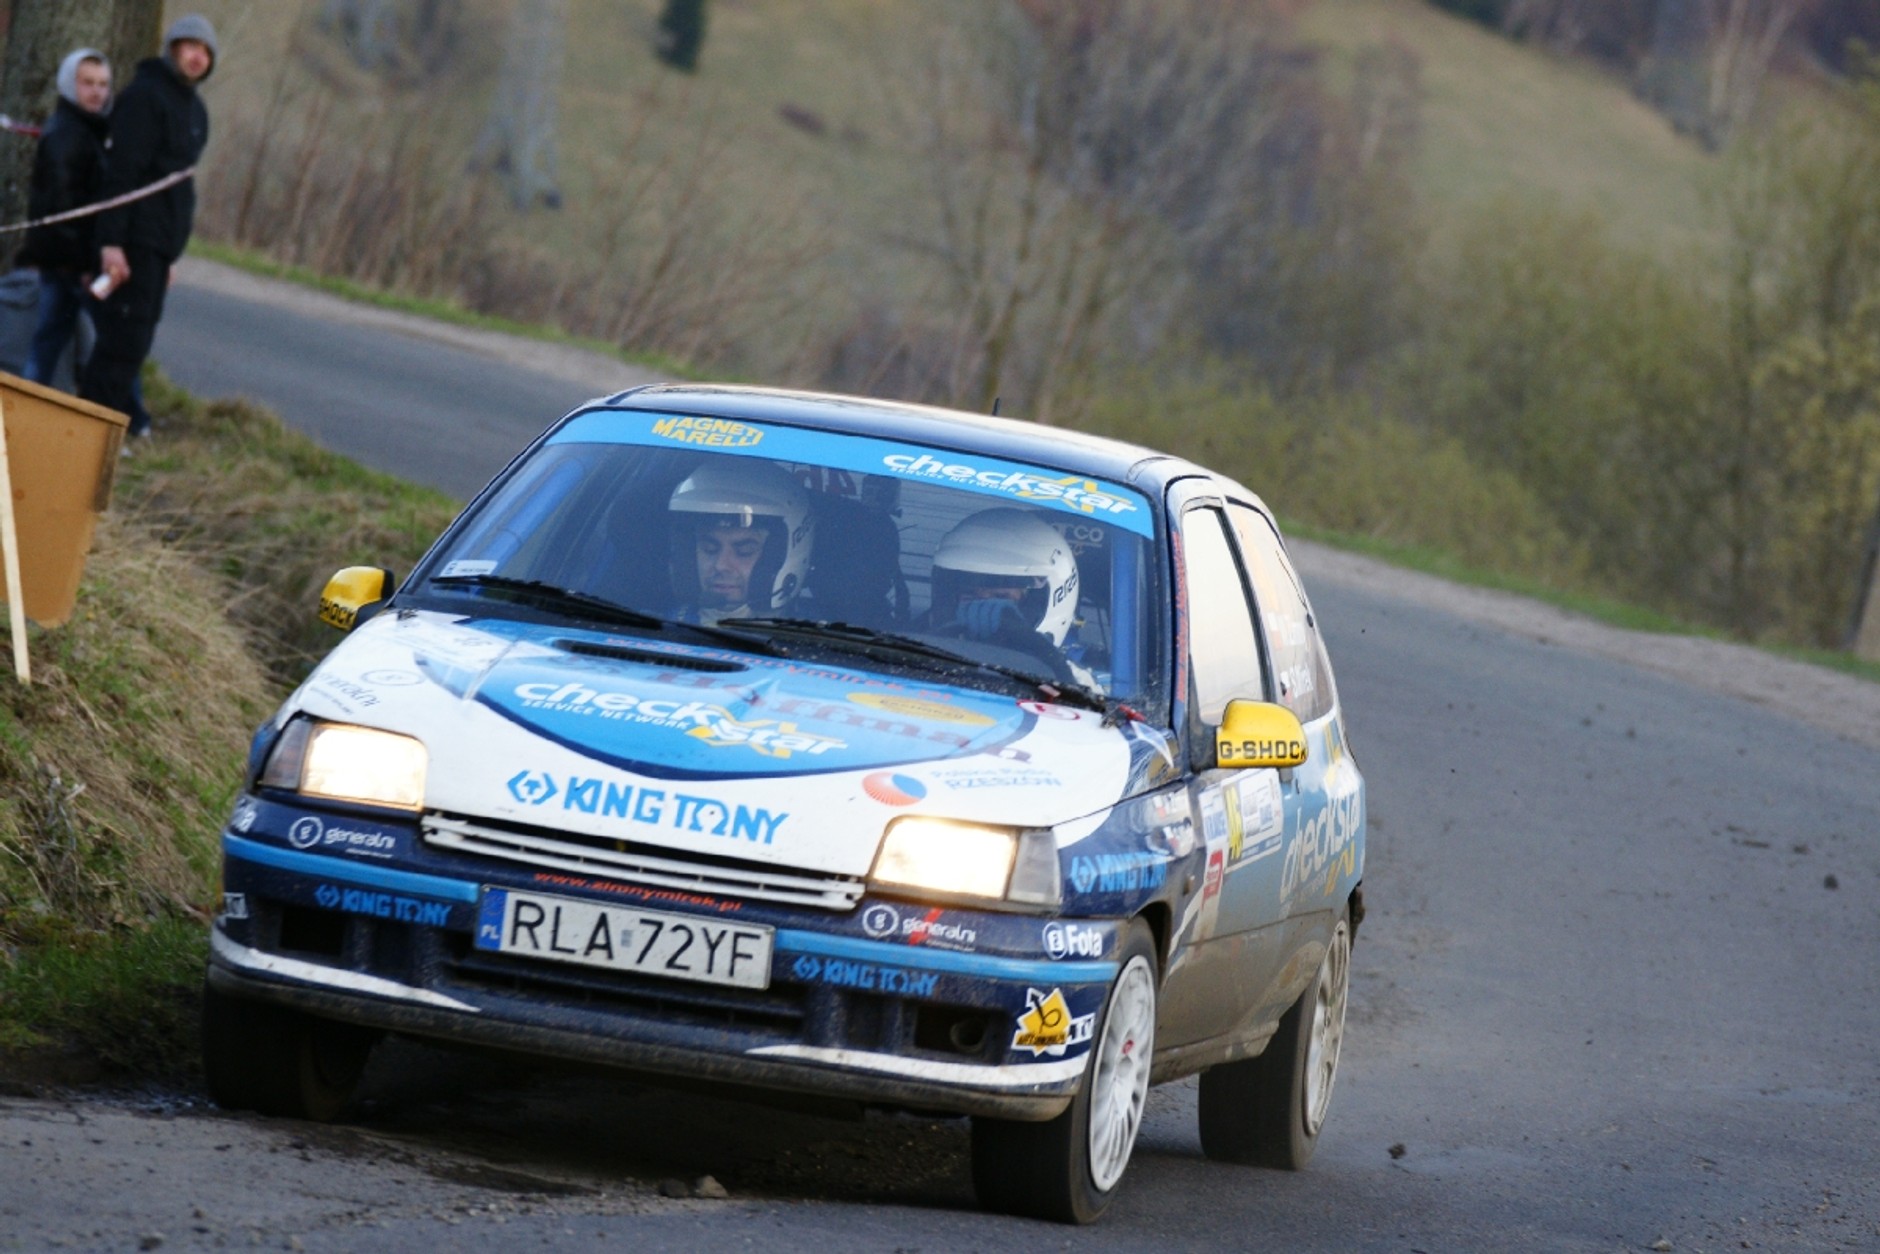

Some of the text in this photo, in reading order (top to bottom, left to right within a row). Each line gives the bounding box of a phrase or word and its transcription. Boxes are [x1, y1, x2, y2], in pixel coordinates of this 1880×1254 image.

[882, 454, 1138, 514] checkstar
[513, 681, 849, 755] checkstar
[521, 701, 691, 730] SERVICE NETWORK
[563, 776, 790, 845] KING TONY
[341, 889, 452, 927] KING TONY
[480, 923, 499, 940] PL
[509, 899, 762, 978] RLA 72YF
[822, 958, 940, 997] KING TONY
